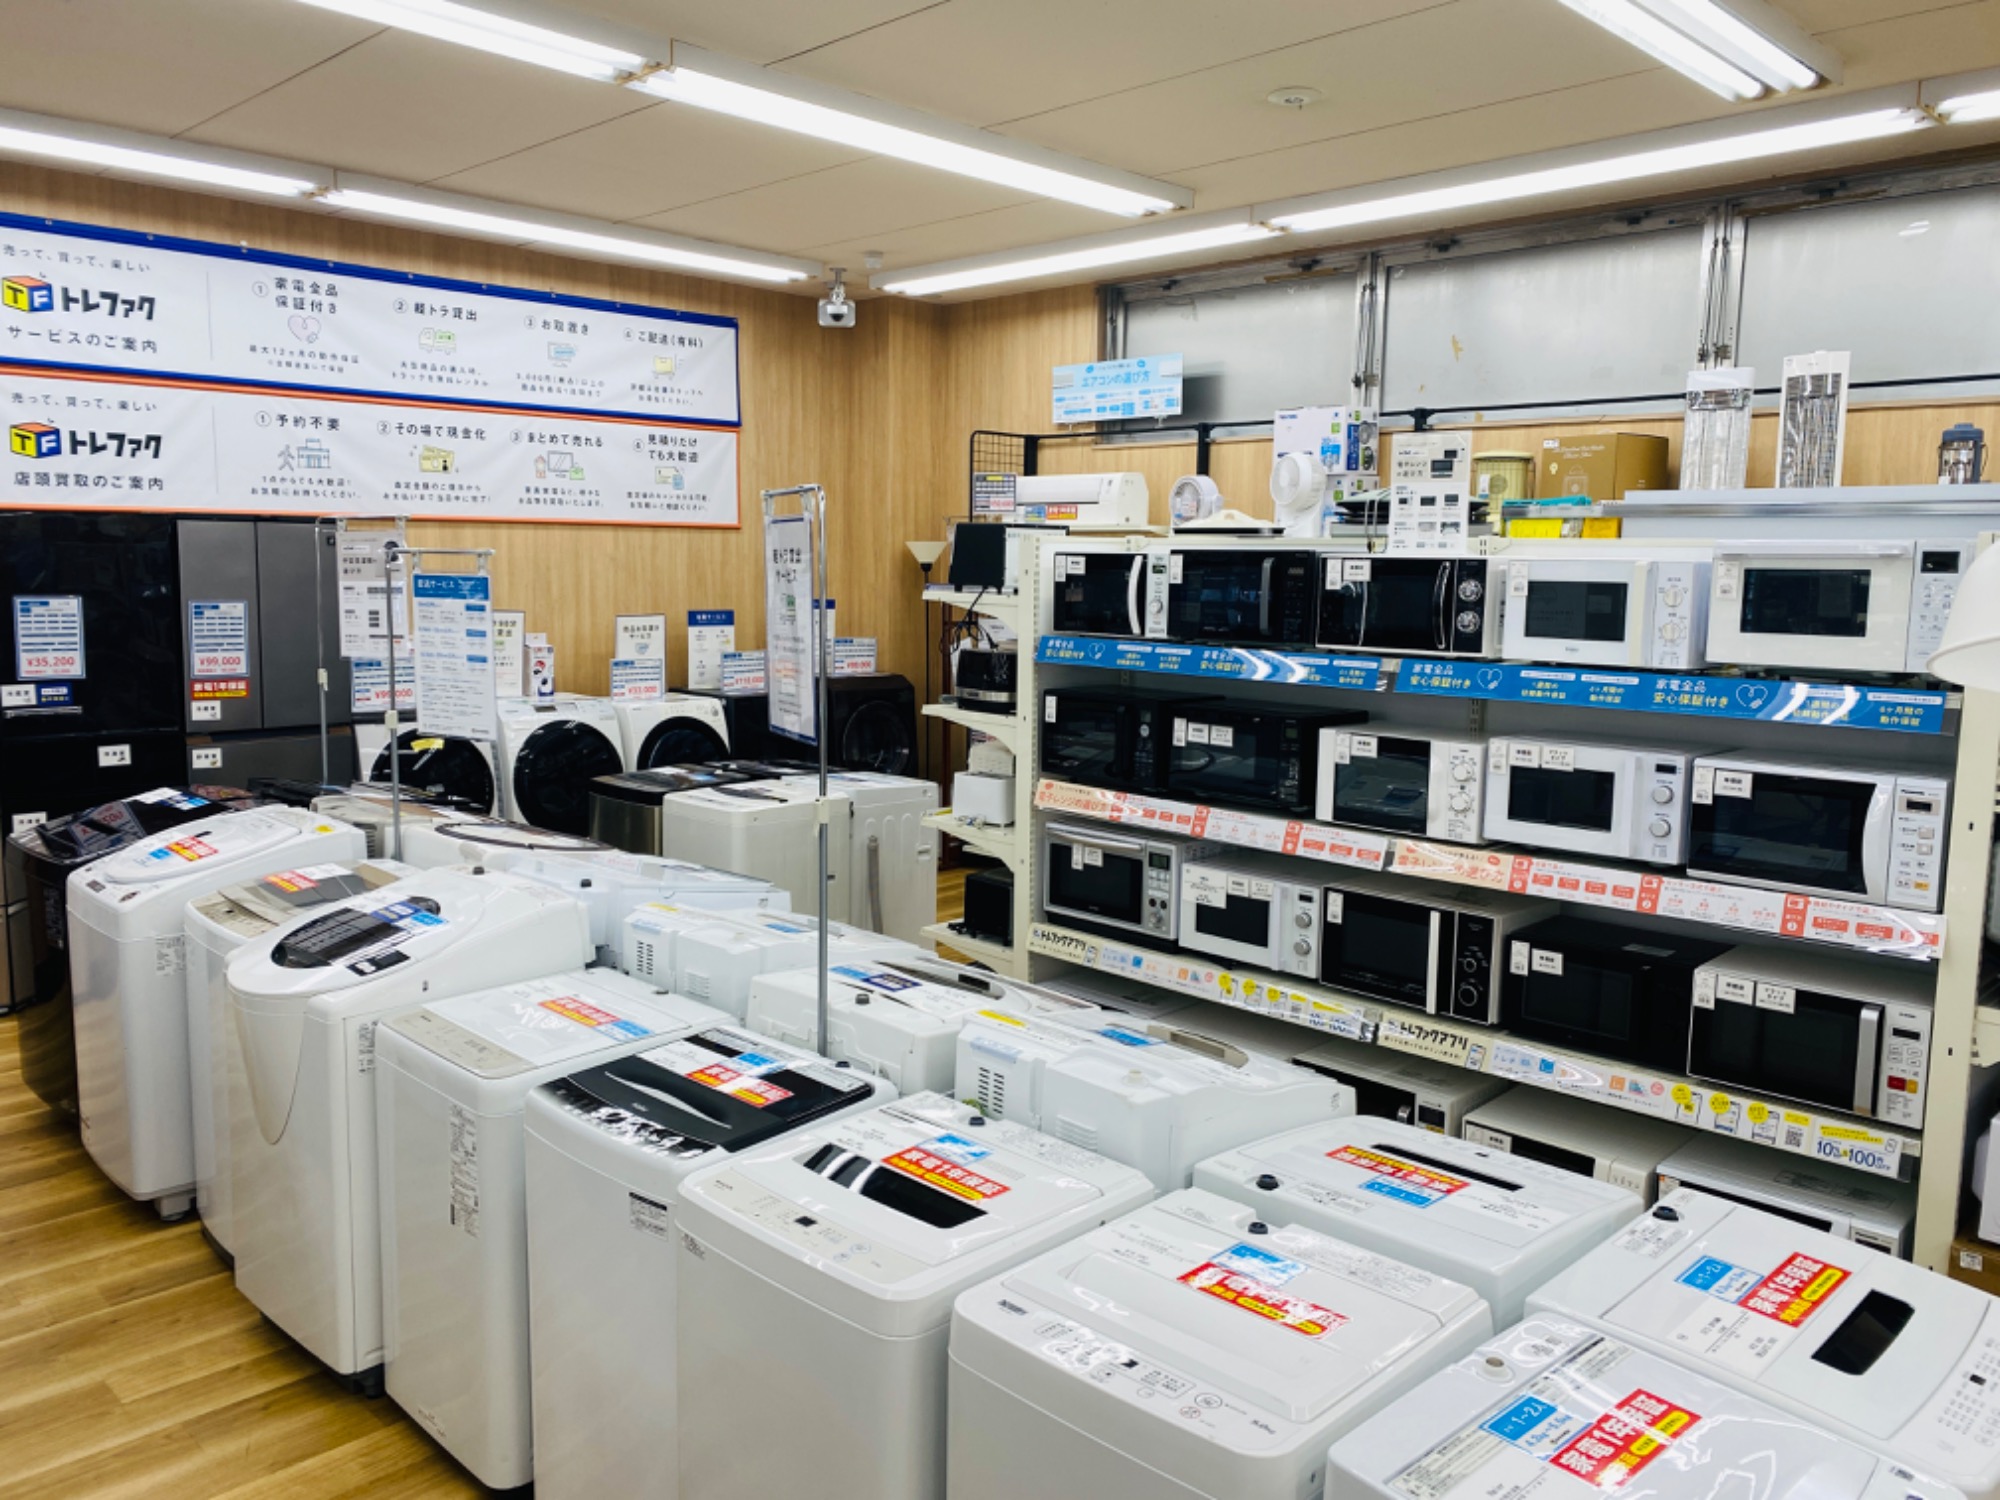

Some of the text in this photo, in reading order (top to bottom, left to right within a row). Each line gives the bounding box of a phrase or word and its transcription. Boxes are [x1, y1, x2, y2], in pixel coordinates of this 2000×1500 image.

[2, 244, 151, 273] 売って、買って、楽しい
[274, 277, 339, 298] 家電全品
[61, 286, 156, 320] トレファク
[274, 295, 338, 315] 保証付き
[414, 302, 478, 323] 軽トラ貸出
[541, 319, 590, 336] お取置き
[7, 325, 158, 354] サービスのご案内
[1081, 370, 1151, 388] エアコンの選び方
[11, 391, 157, 412] 売って、買って、楽しい
[275, 413, 341, 432] 予約不要
[394, 422, 486, 442] その場で現金化
[69, 430, 162, 459] トレファク
[527, 432, 604, 449] まとめて売れる
[648, 449, 700, 464] でも大歓迎
[14, 471, 164, 492] 店頭買取のご案内
[25, 656, 75, 668] ¥35,200
[1412, 663, 1454, 676] 家電全品
[1410, 675, 1472, 689] 安心保証付き
[1656, 677, 1706, 693] 家電全品
[1653, 691, 1729, 708] 安心保証付き
[1747, 1255, 1826, 1315] 家電1年保証
[1558, 1393, 1670, 1476] 家電1年保証
